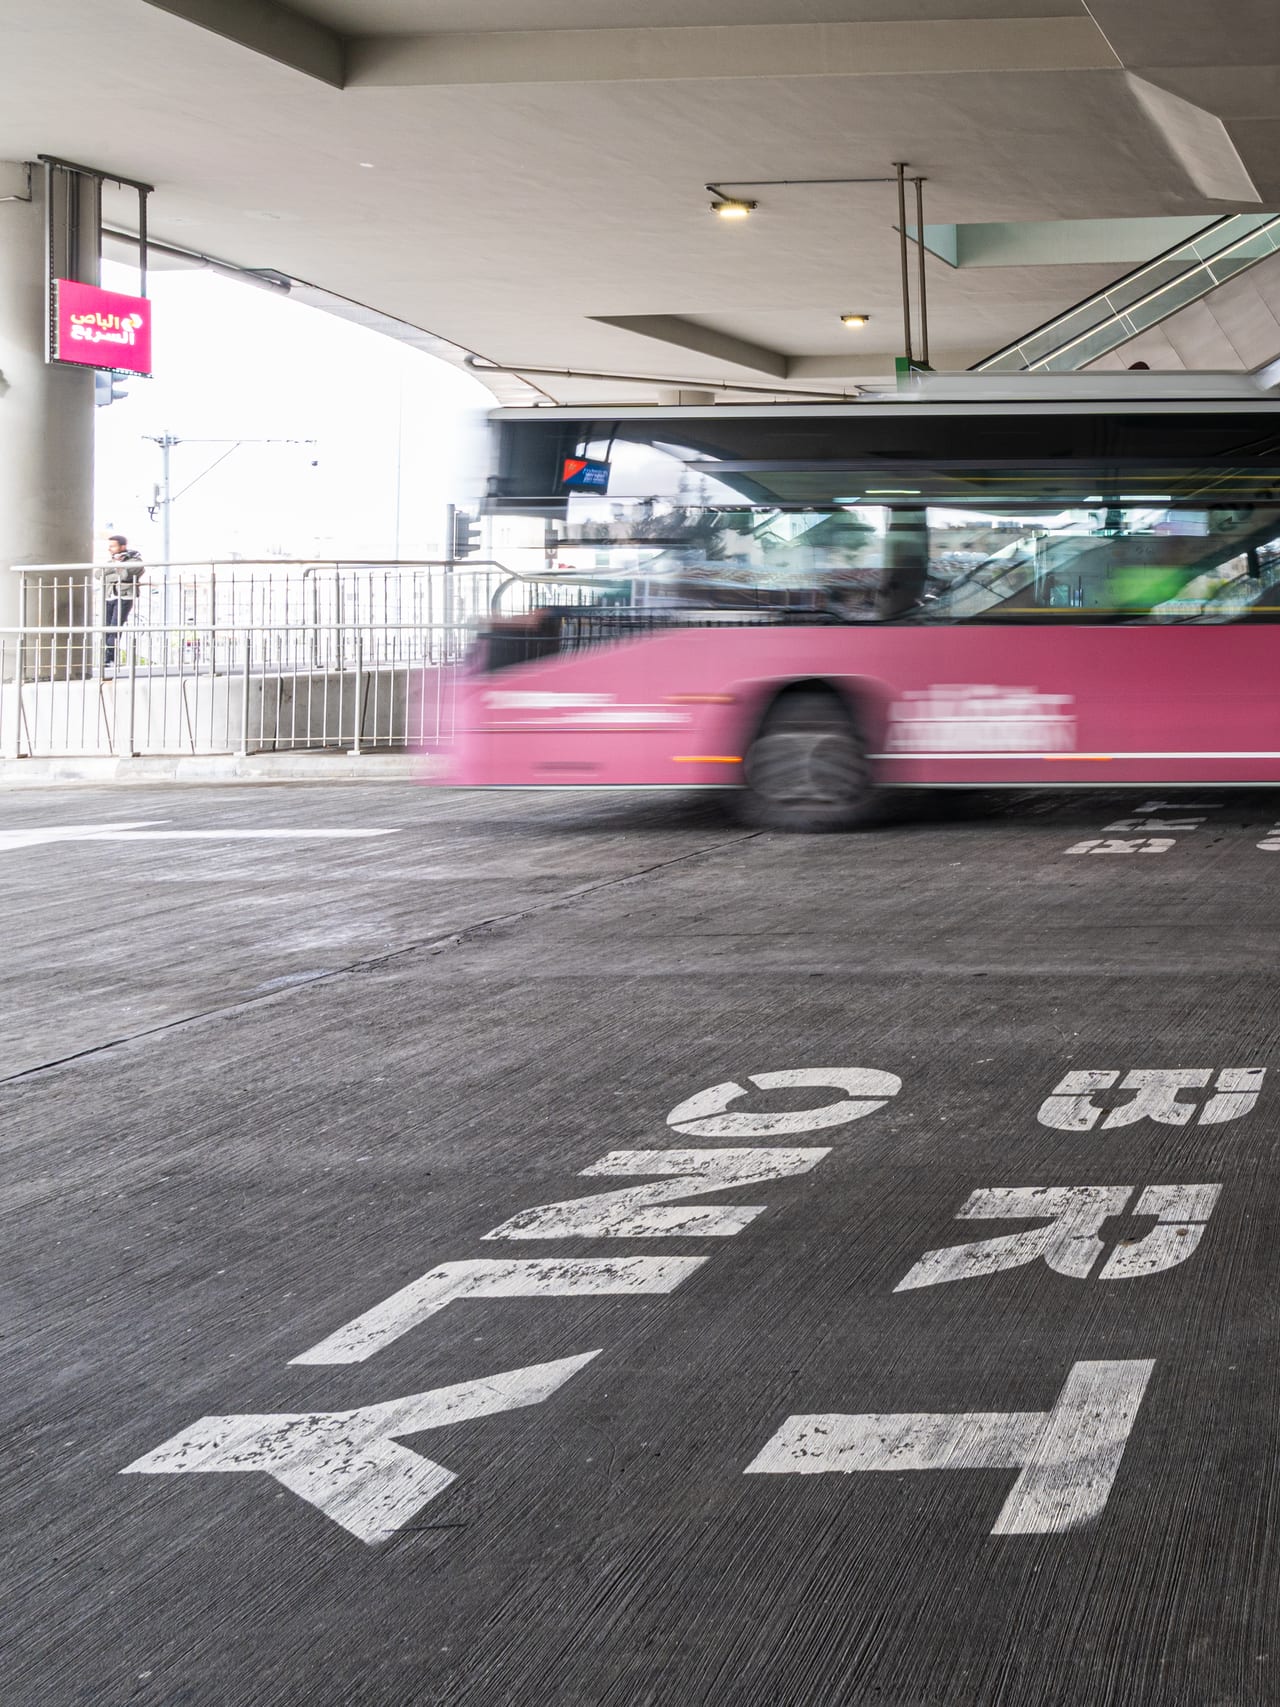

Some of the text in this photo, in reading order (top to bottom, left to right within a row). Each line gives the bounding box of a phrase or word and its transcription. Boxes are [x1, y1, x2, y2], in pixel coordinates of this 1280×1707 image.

[70, 312, 120, 330] الباص
[70, 324, 135, 346] السريع
[1064, 801, 1224, 854] BRT
[119, 1067, 902, 1545] ONLY
[744, 1068, 1267, 1535] BRT
